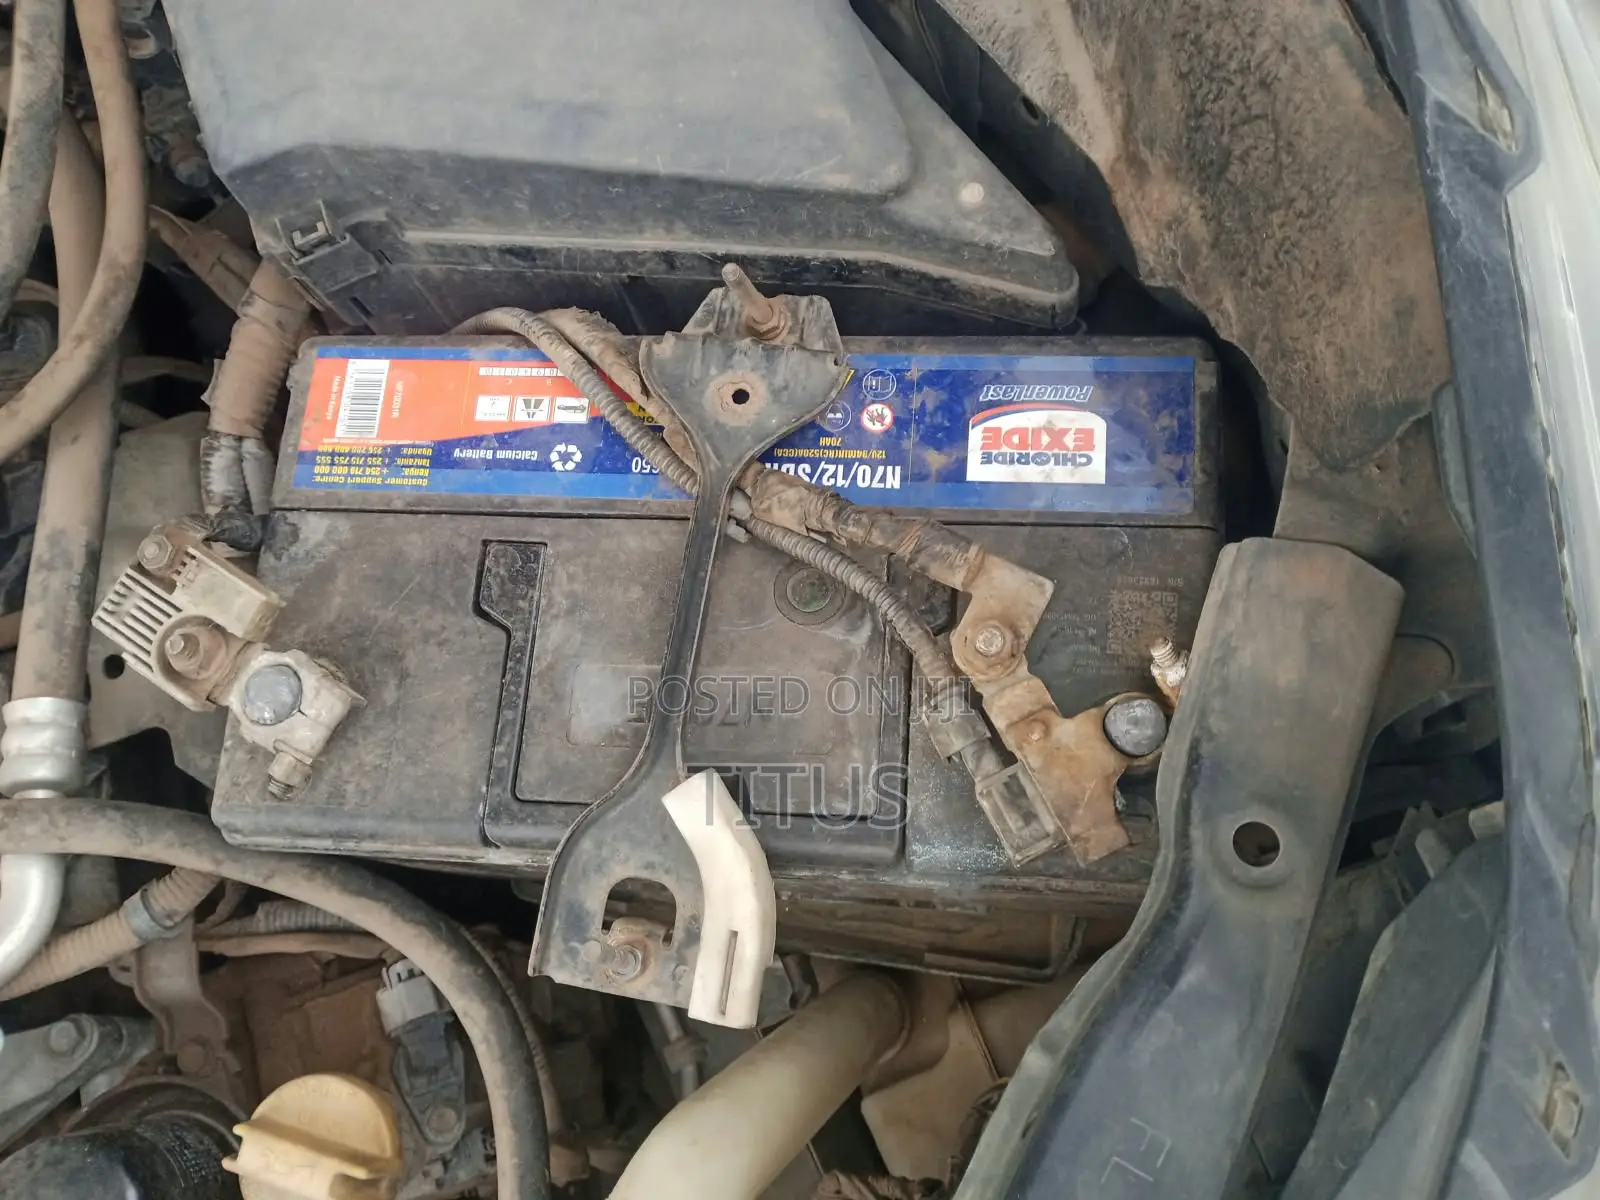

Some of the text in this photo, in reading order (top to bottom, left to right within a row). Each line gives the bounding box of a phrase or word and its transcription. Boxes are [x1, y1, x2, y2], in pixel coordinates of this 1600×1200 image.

[979, 385, 1093, 402] PowerLast
[819, 436, 842, 447] 70AH
[980, 427, 1096, 452] EXIDE
[453, 447, 538, 461] Calcium Battery
[980, 451, 1093, 467] CHLORIDE
[401, 467, 429, 476] Kenya:
[312, 475, 428, 486] Customer Support Centre:
